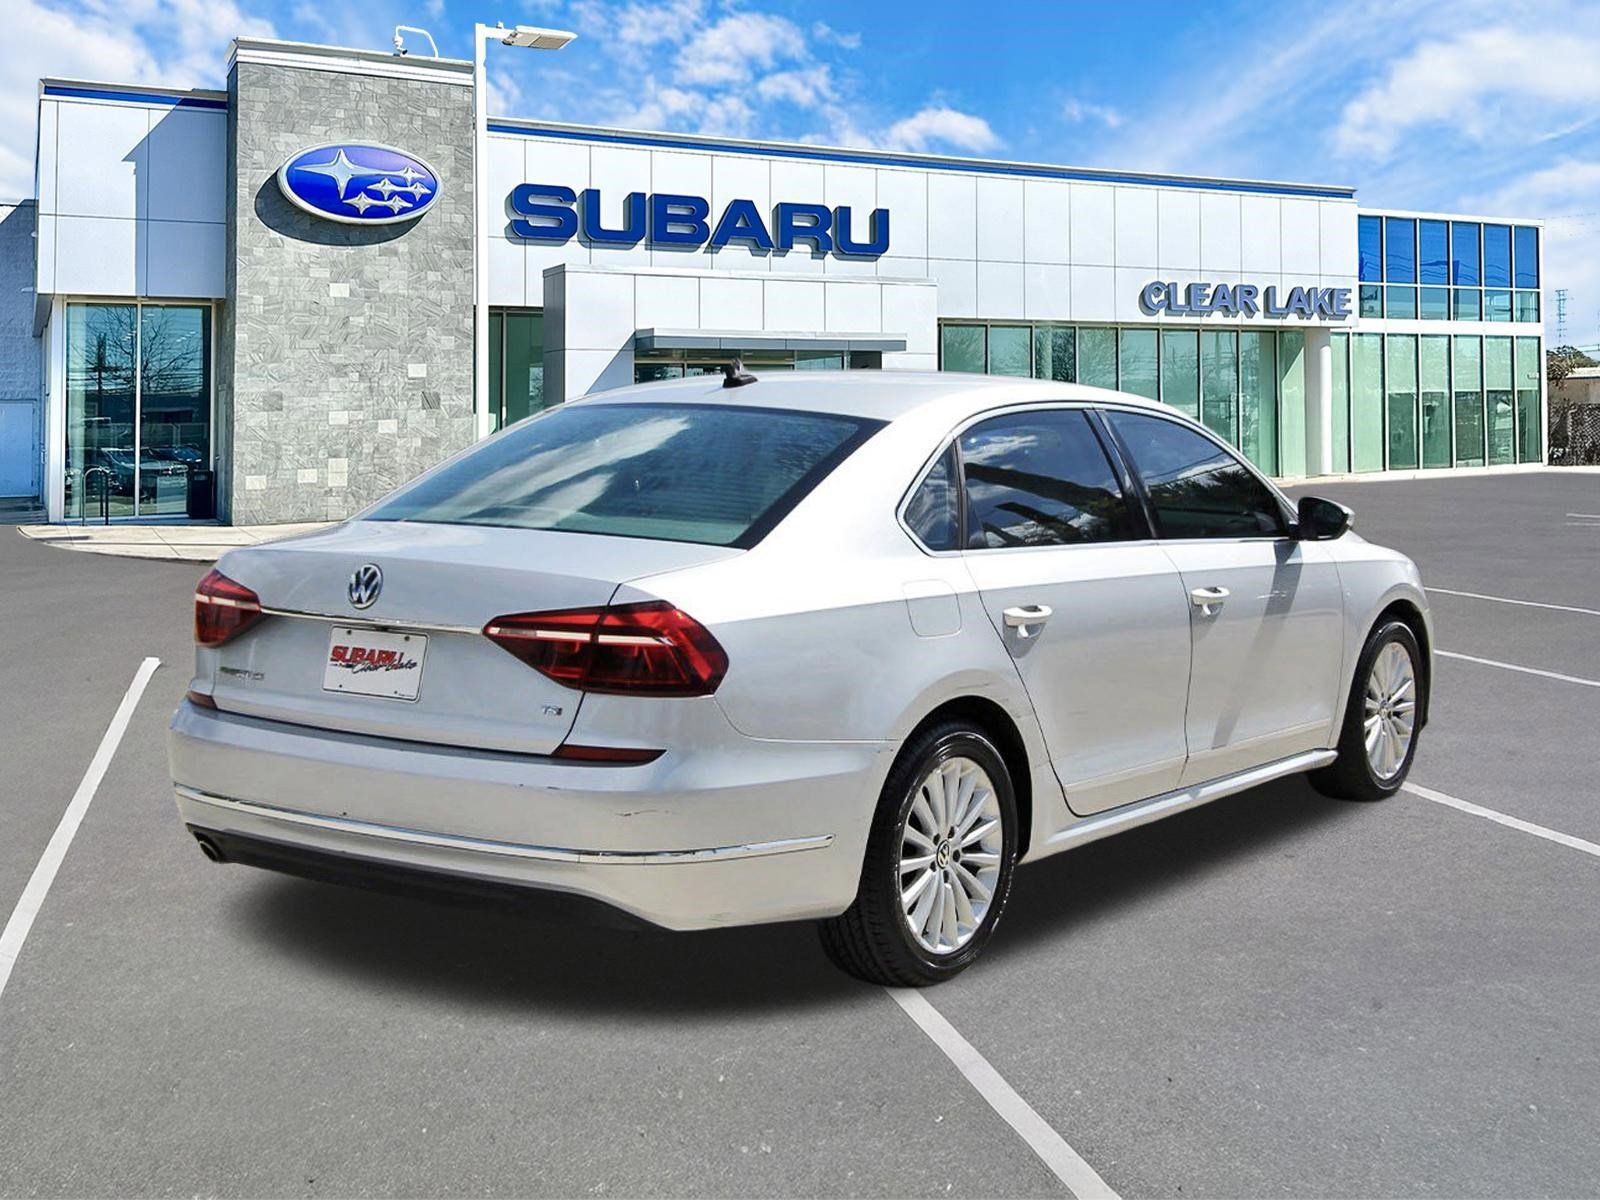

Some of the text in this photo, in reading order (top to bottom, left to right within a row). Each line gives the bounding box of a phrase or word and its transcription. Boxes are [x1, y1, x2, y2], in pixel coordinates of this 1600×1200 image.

[506, 183, 890, 256] SUBARU
[1139, 281, 1352, 319] CLEAR LAKE
